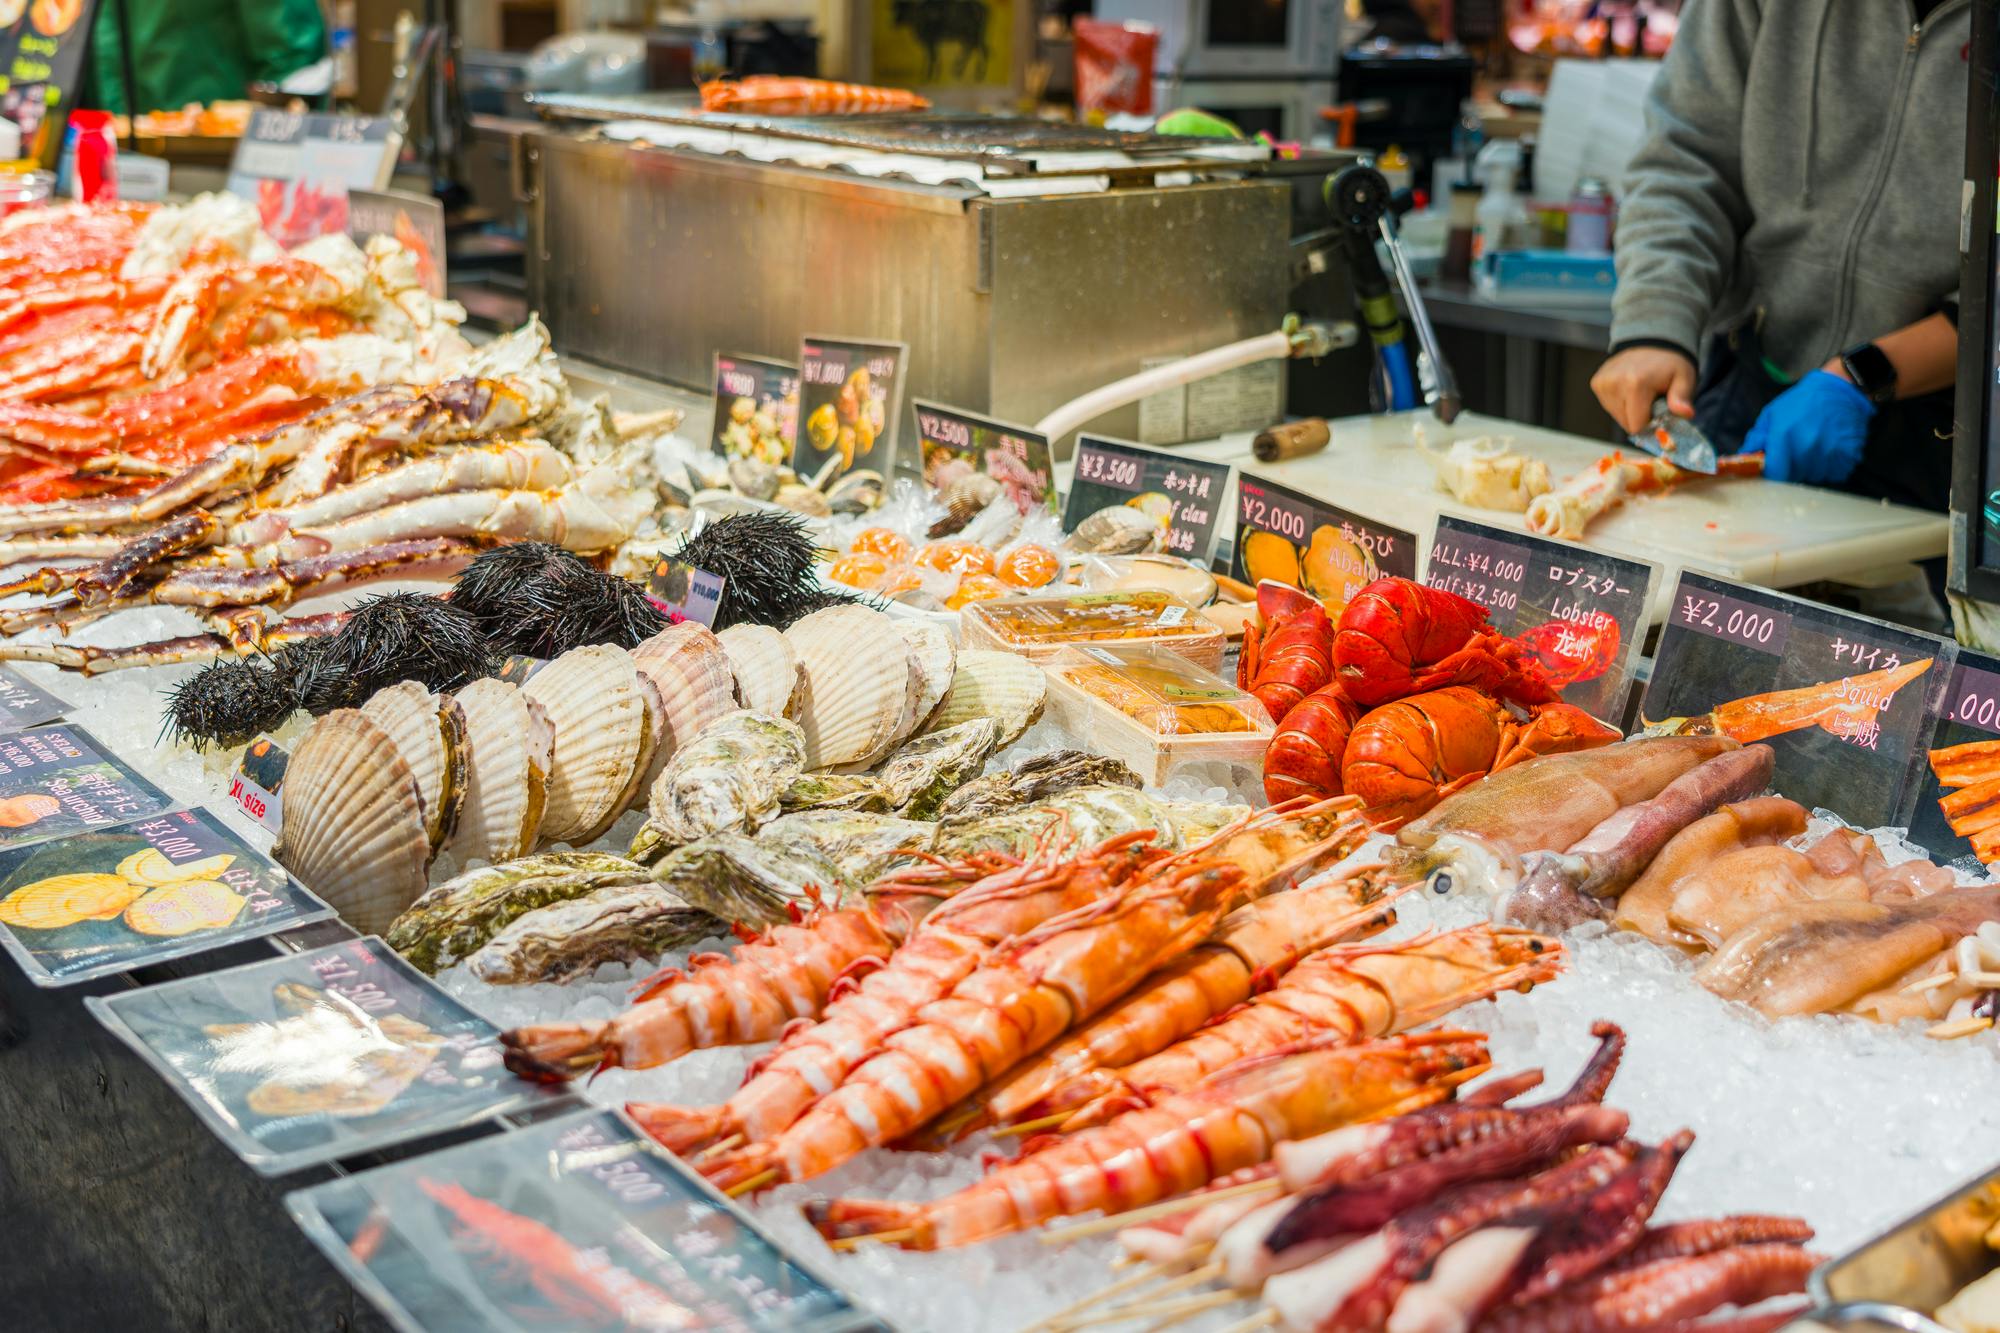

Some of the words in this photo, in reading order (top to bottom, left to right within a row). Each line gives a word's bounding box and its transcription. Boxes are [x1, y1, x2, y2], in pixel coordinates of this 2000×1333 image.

[920, 414, 969, 447] ¥2,500
[1080, 453, 1137, 486] ¥3,500
[1163, 470, 1211, 499] ホッキ貝
[1242, 495, 1304, 539] ¥2,000
[1341, 521, 1394, 557] あわび
[1328, 547, 1396, 582] Abalon
[1431, 543, 1523, 582] ALL:¥4,000
[1549, 565, 1630, 595] ロブスター
[1550, 597, 1613, 631] Lobster
[1681, 595, 1774, 643] ¥2,000
[1553, 629, 1598, 662] 龙虾
[1830, 637, 1900, 674] ヤリイカ
[1835, 677, 1895, 712] Squid
[229, 779, 244, 802] XL
[243, 792, 266, 819] size
[138, 819, 202, 859] ¥3,000
[221, 867, 284, 914] ほたて貝
[309, 954, 398, 1011] ¥1,500
